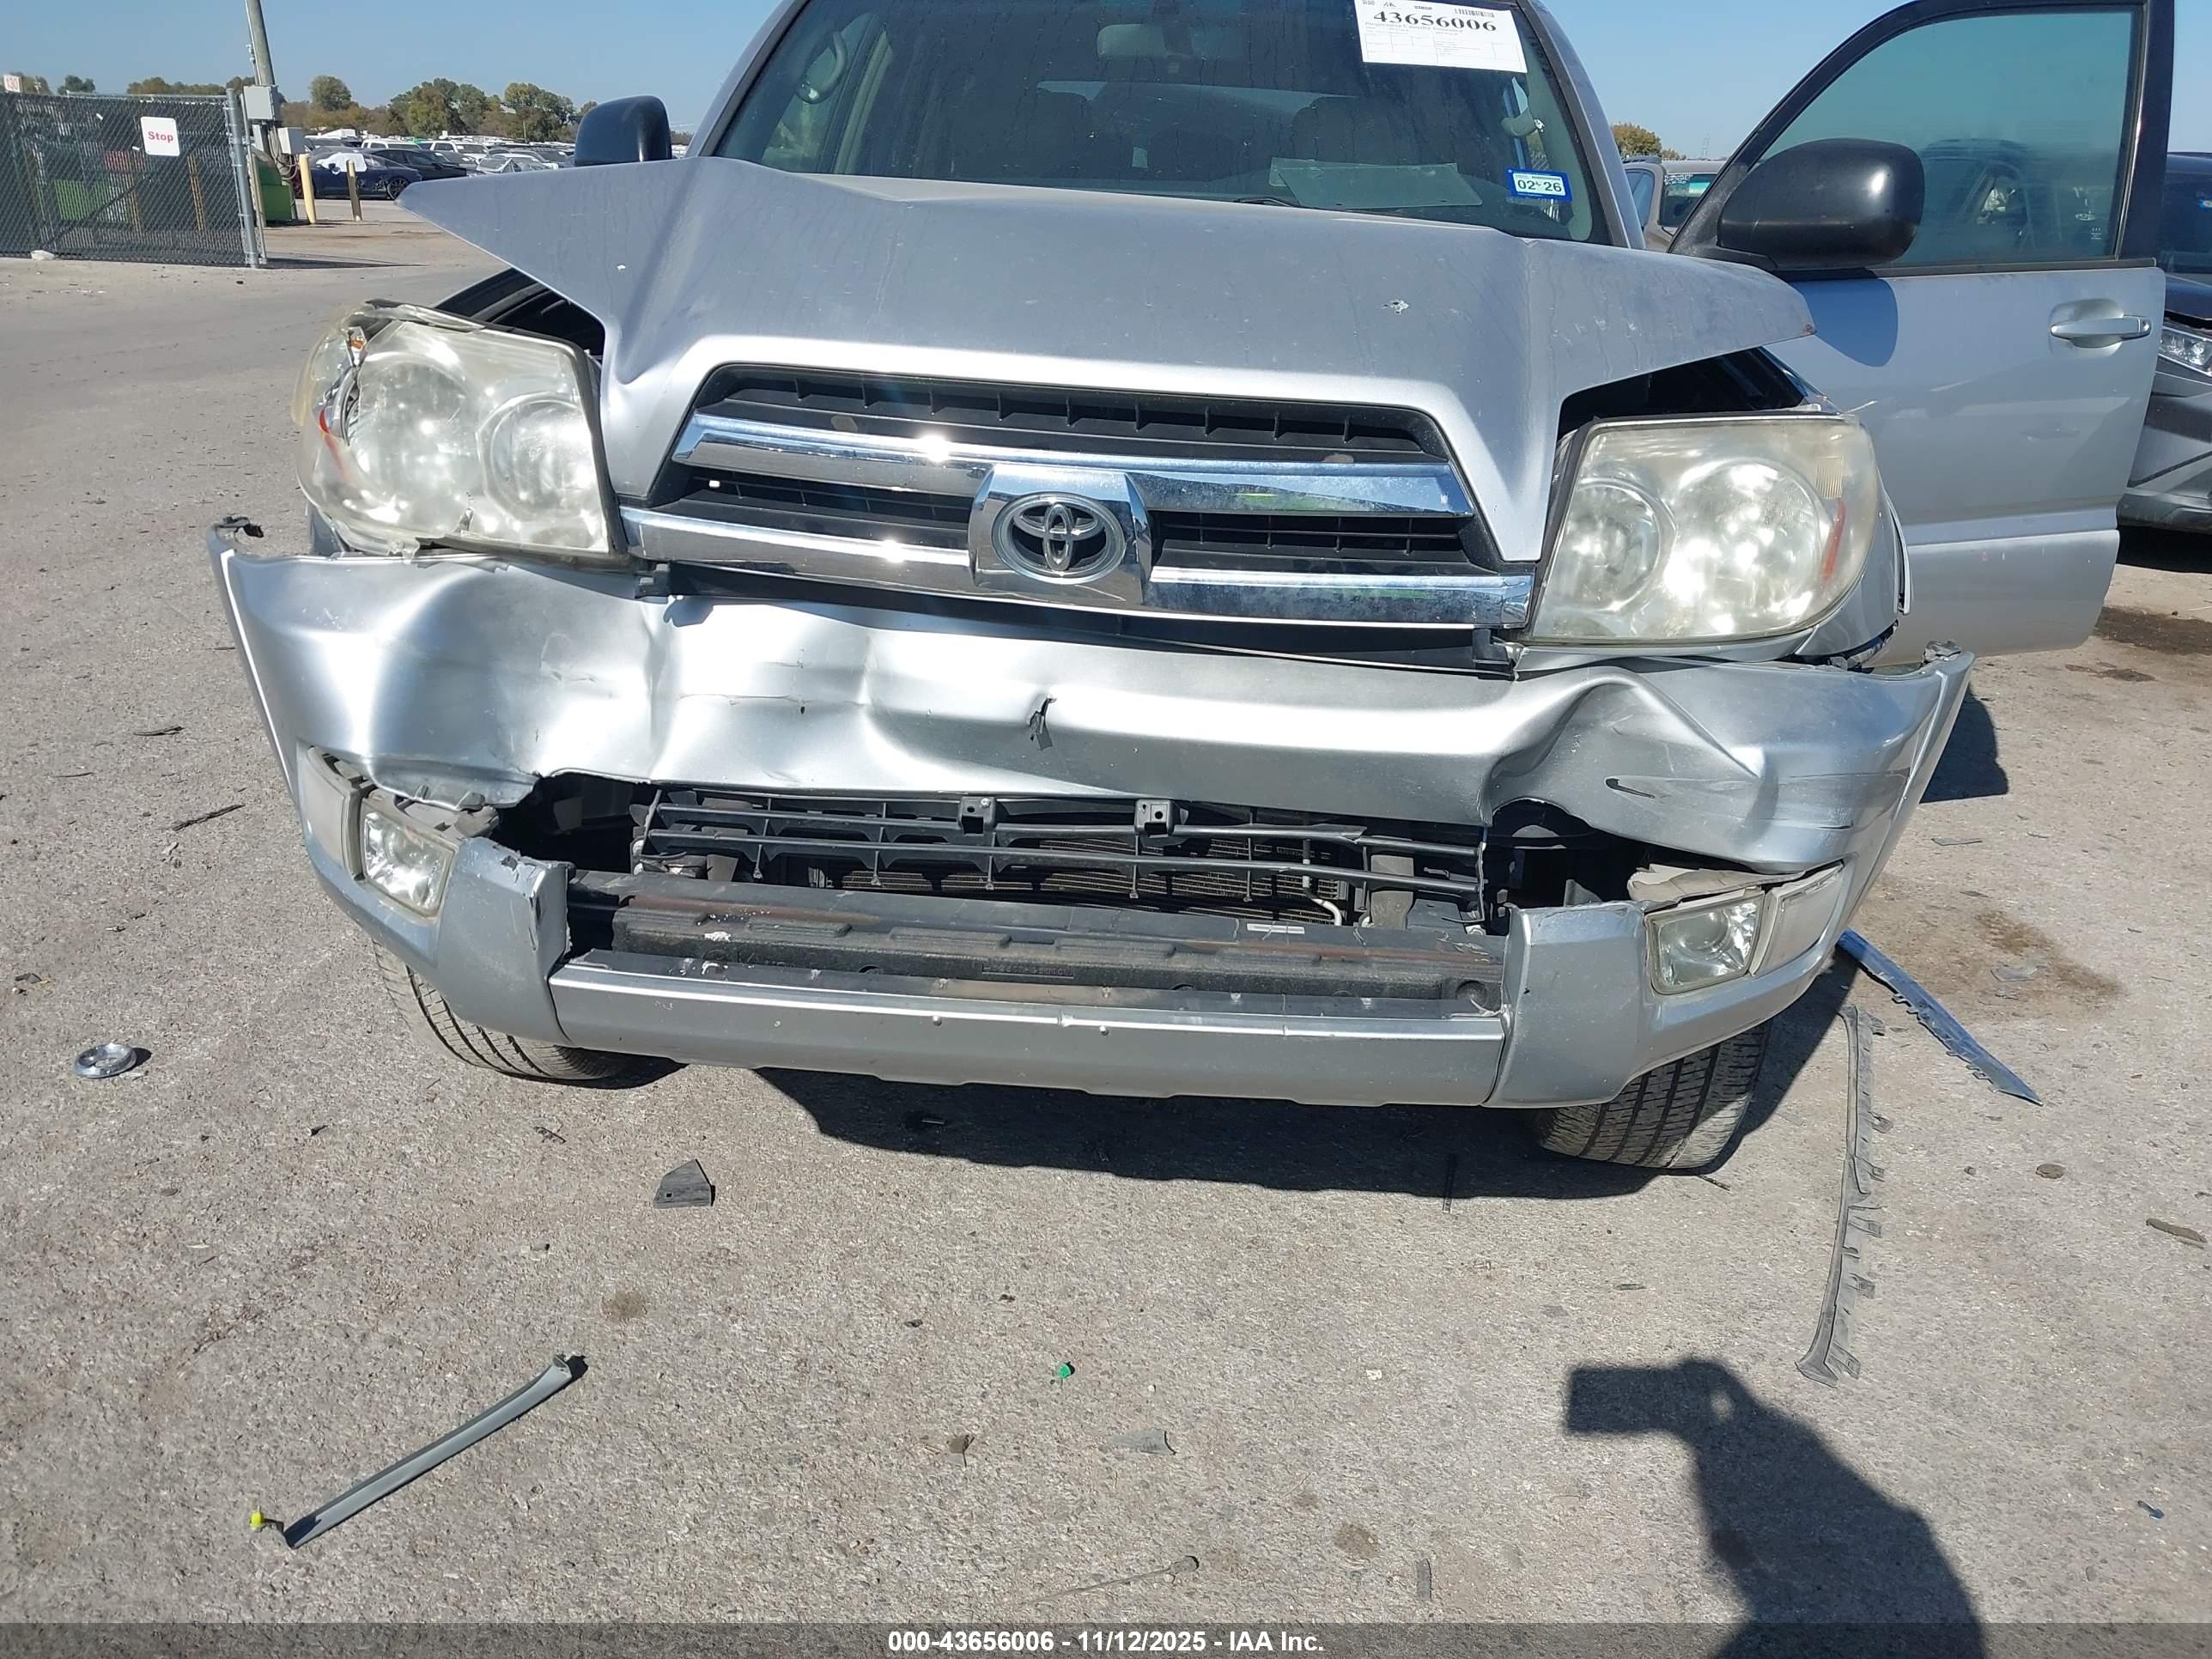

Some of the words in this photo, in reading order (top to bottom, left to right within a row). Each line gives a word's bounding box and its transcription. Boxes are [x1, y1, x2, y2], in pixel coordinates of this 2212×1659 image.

[1373, 10, 1497, 32] 43656006
[148, 131, 174, 143] Stop
[1543, 181, 1561, 191] 26
